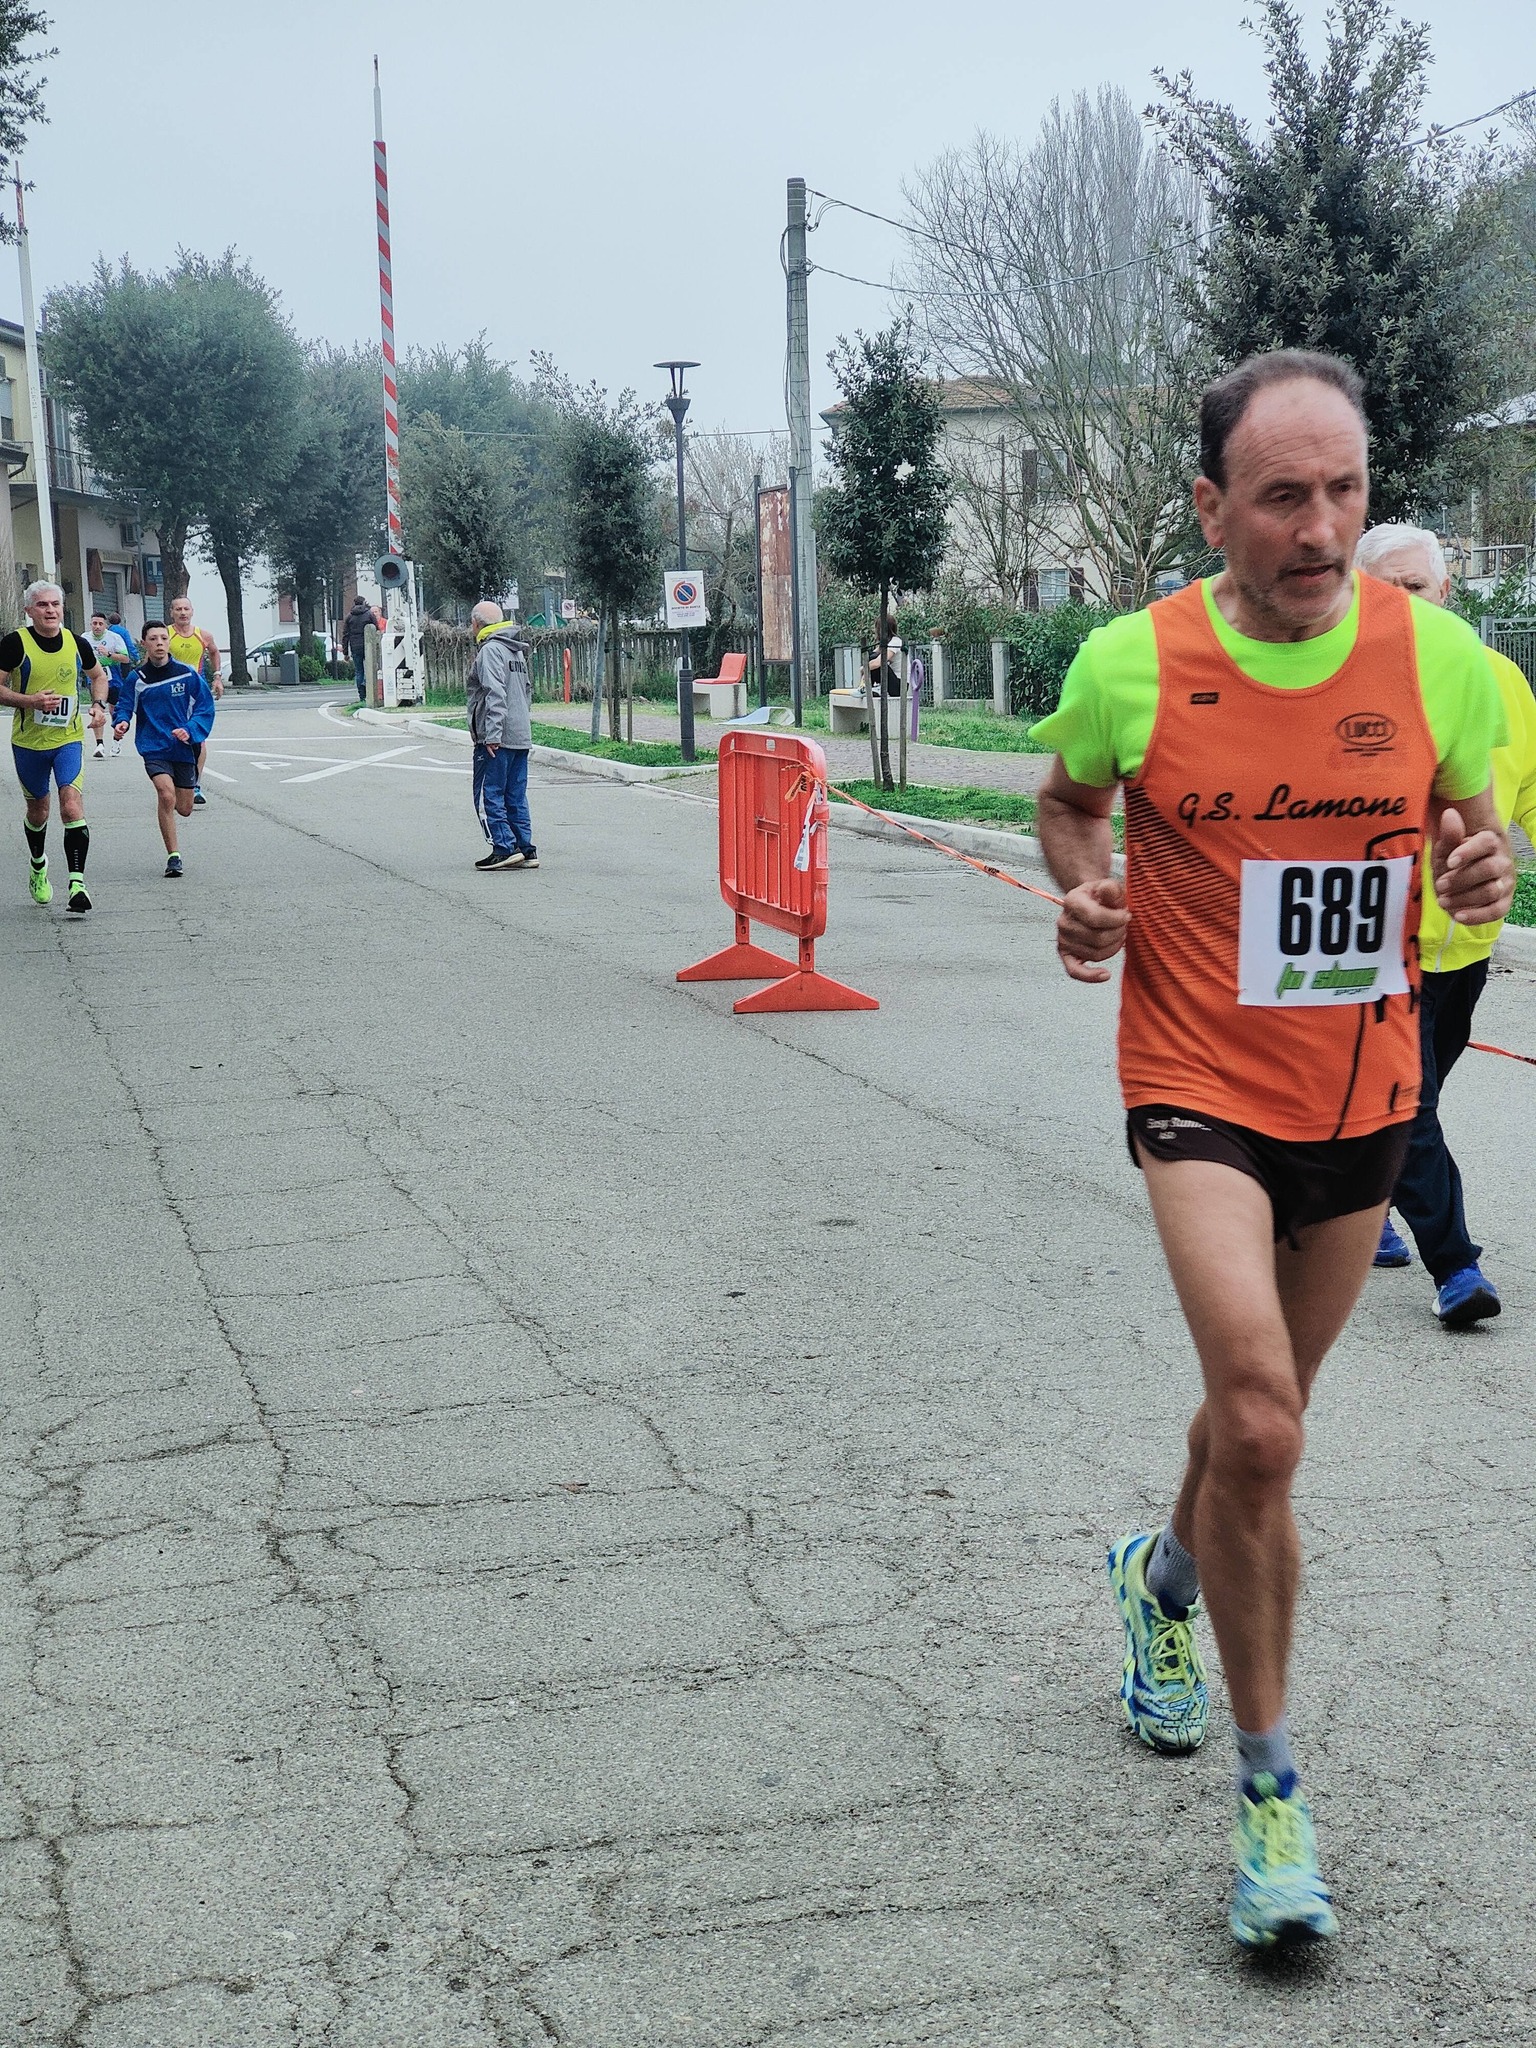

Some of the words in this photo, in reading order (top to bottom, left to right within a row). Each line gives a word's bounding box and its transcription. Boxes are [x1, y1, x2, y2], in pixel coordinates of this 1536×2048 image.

[1177, 792, 1241, 828] G.S.
[1253, 783, 1408, 821] Lamone
[1279, 865, 1388, 956] 689
